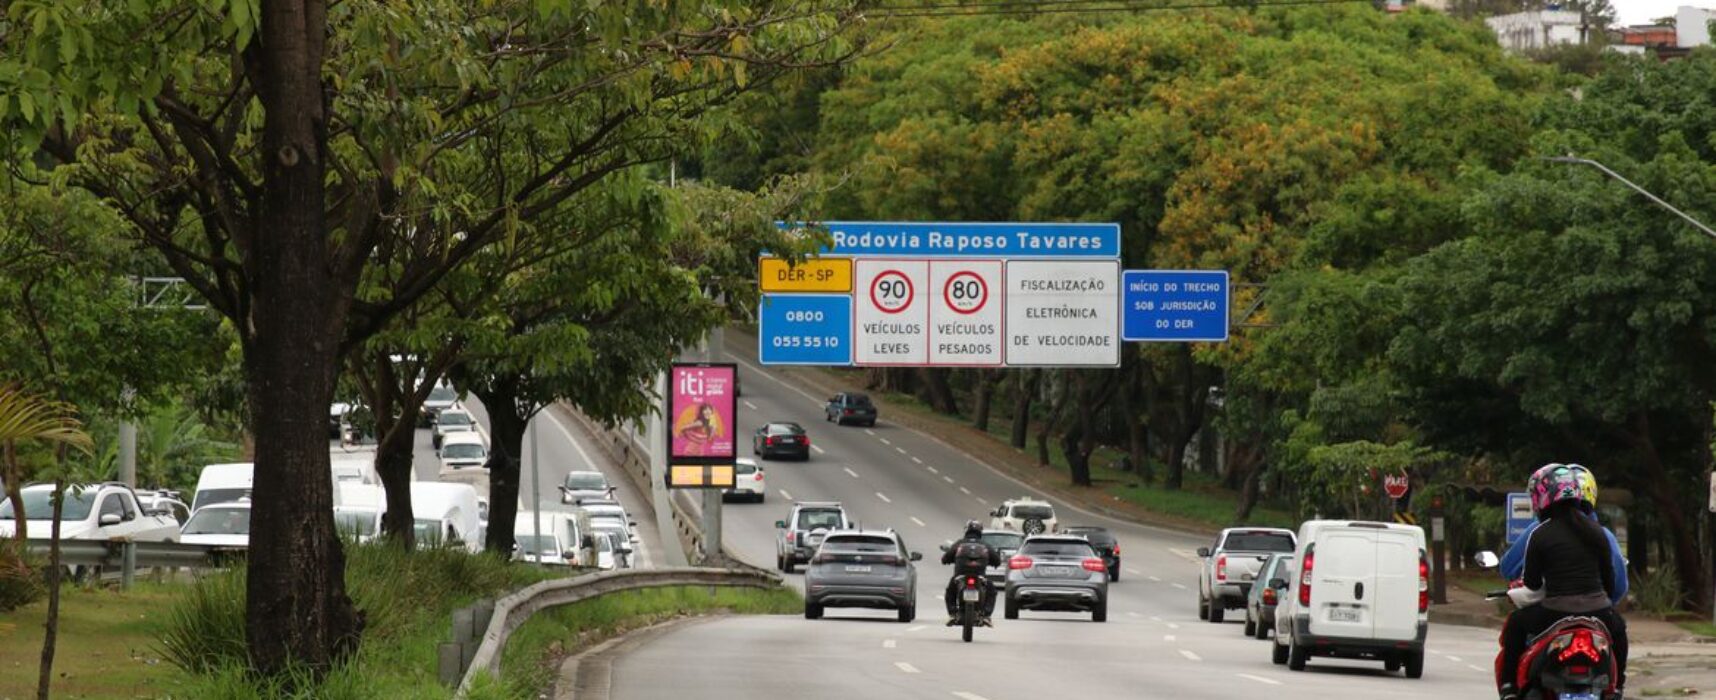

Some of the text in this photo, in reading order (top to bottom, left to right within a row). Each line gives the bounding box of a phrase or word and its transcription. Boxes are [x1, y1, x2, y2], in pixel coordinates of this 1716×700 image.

[833, 231, 1102, 252] Rodovia Raposo Tavares
[879, 279, 906, 299] 90
[952, 280, 979, 300] 80
[1020, 277, 1105, 292] FISCALIZAÇÃO
[1130, 279, 1220, 292] INÍCIO DO TRECHO
[1026, 303, 1098, 319] ELETRÔNICA
[1134, 299, 1217, 312] SOB JURISDIÇÃO
[785, 311, 824, 322] 0800
[1155, 319, 1194, 329] DO DER
[863, 320, 921, 335] VEÍCULOS
[937, 320, 995, 336] VEÍCULOS
[873, 343, 910, 354] LEVES
[1014, 335, 1111, 347] DE VELOCIDADE
[938, 344, 992, 355] PESADOS
[680, 370, 704, 396] iti
